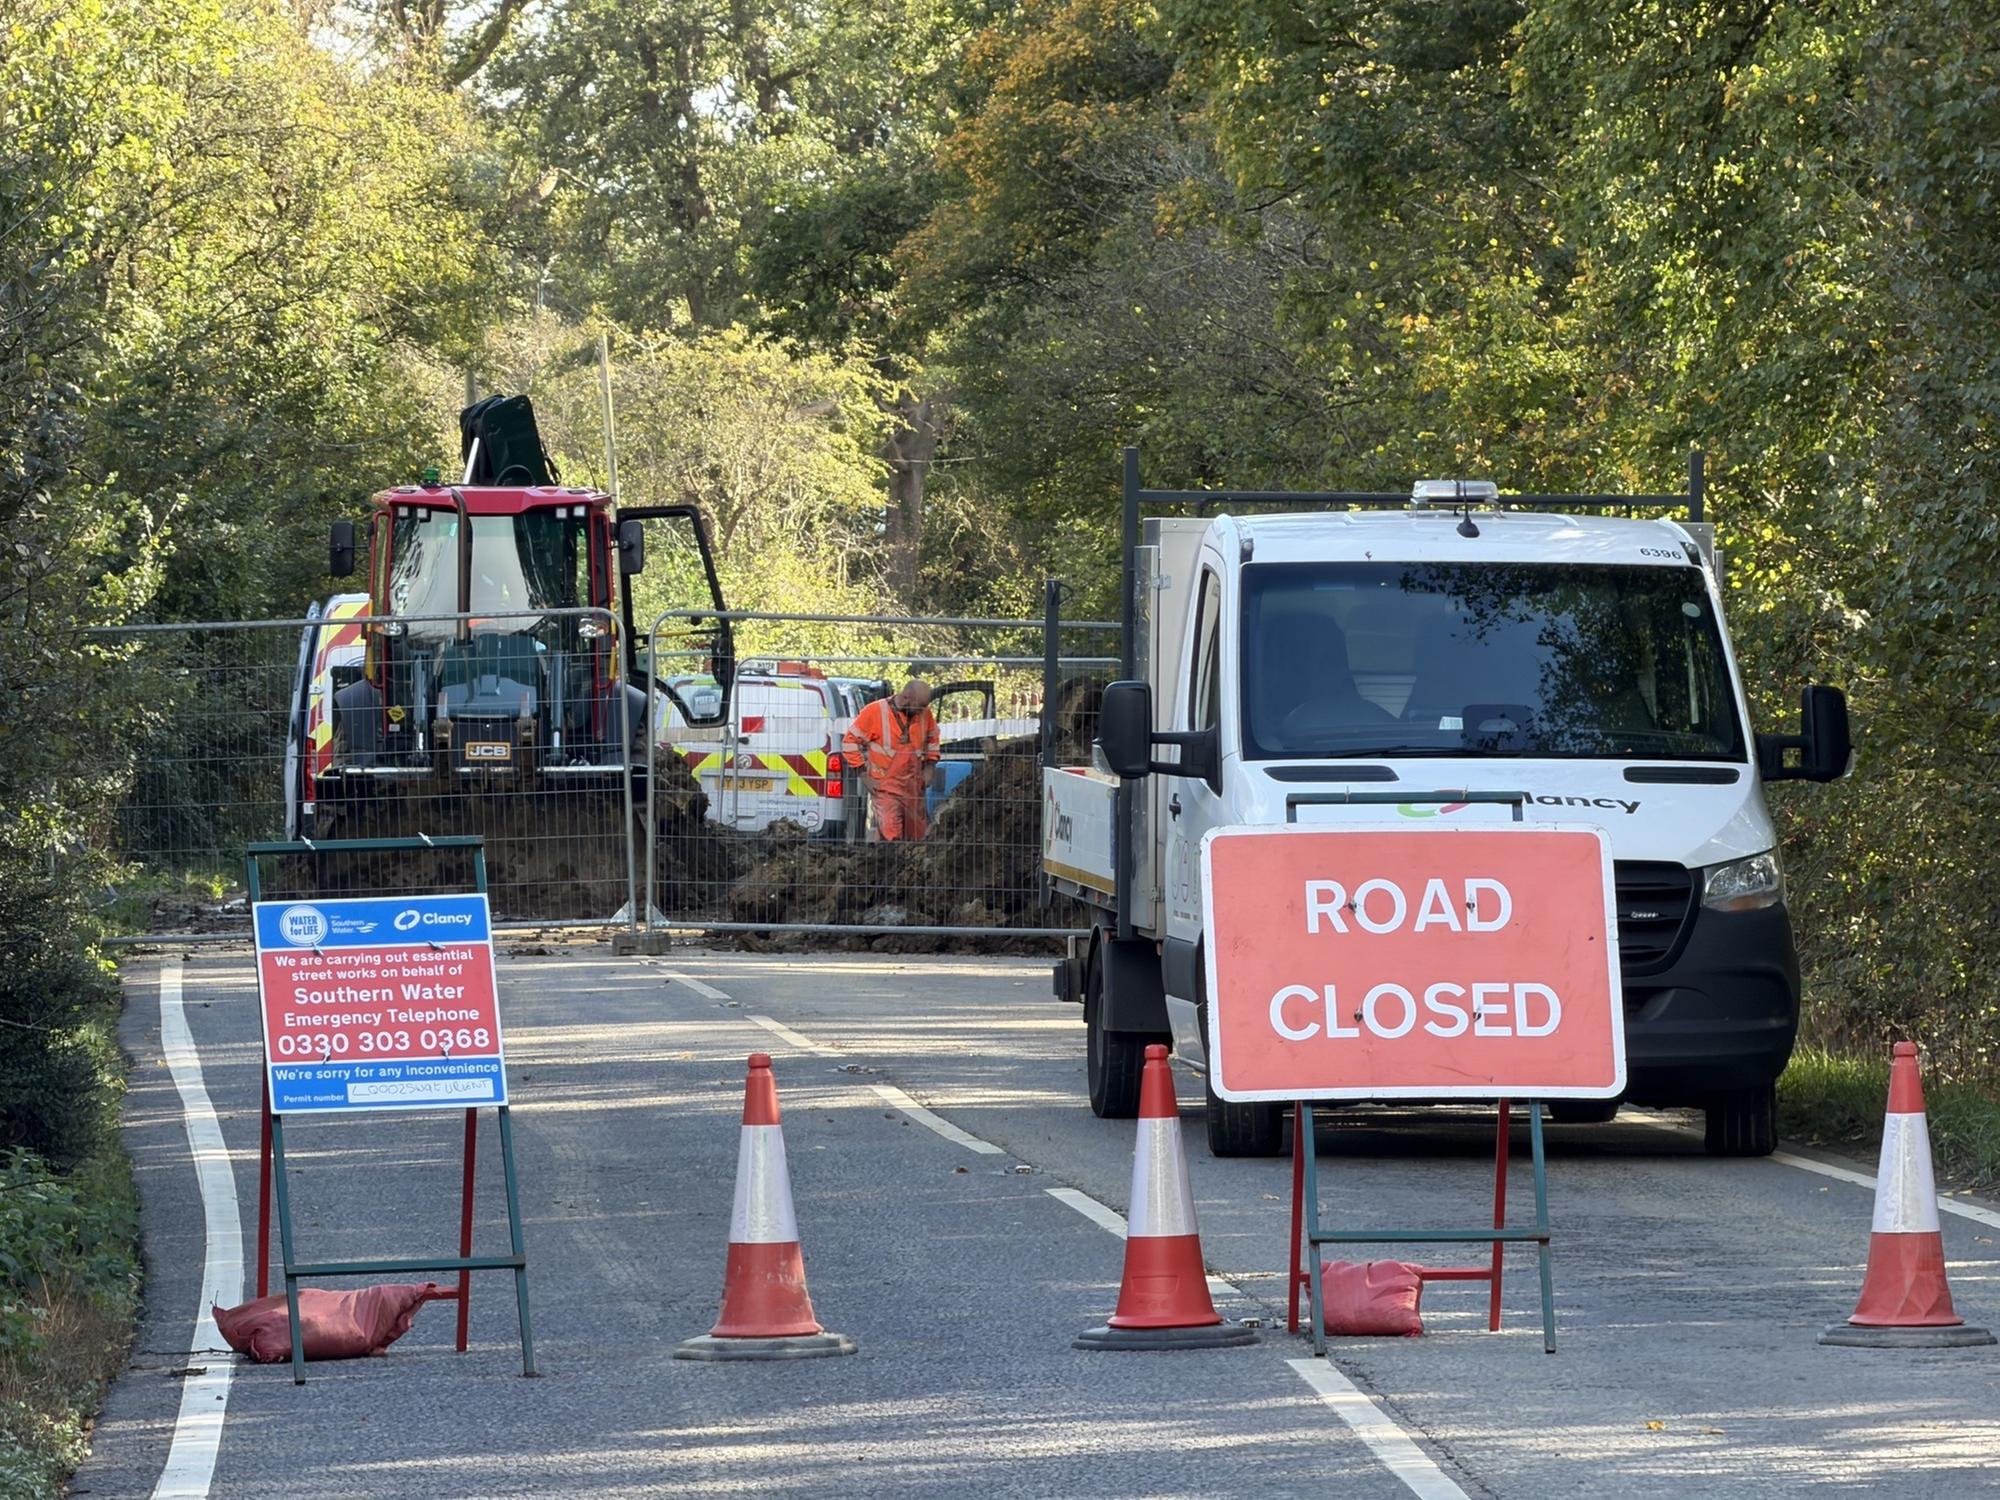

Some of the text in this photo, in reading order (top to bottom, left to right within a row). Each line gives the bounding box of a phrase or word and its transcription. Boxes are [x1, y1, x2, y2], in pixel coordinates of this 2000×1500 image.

[1640, 547, 1682, 560] 6396
[469, 745, 507, 757] JCB
[1520, 791, 1641, 814] lancy
[1304, 878, 1513, 935] ROAD
[289, 915, 318, 926] WATER
[331, 920, 365, 928] Southern
[422, 912, 472, 926] Clancy
[290, 925, 319, 936] for LIFE
[332, 927, 354, 935] Water
[274, 949, 473, 967] We are carrying out essential
[291, 964, 463, 982] street works on behalf of
[294, 983, 465, 1005] Southern Water
[284, 1007, 480, 1028] Emergency Telephone
[1268, 983, 1562, 1041] CLOSED
[278, 1027, 490, 1056] 0330 303 0368
[275, 1062, 499, 1081] We're sorry for any inconvenience
[283, 1093, 345, 1103] Permit number
